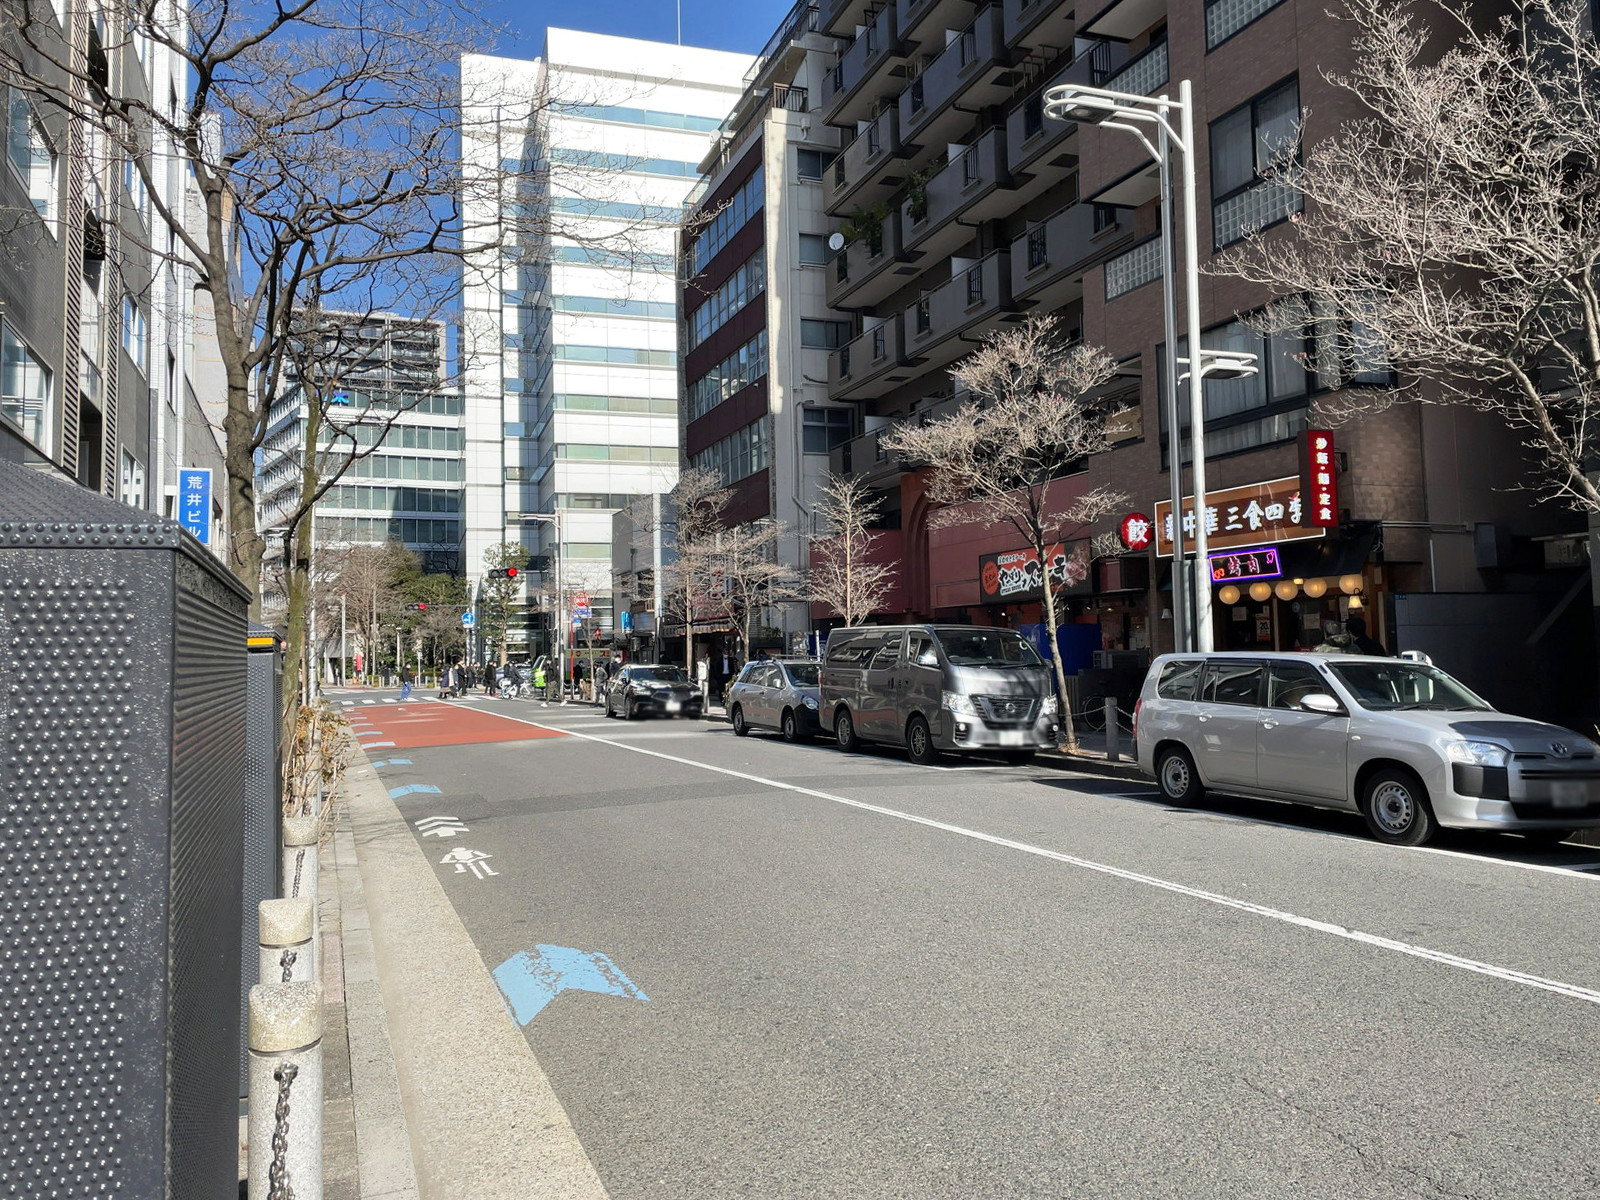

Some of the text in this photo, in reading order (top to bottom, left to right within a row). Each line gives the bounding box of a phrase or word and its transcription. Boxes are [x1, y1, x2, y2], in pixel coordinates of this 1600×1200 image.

[187, 475, 202, 537] 荒井ビル
[1127, 518, 1149, 543] 餃
[999, 556, 1066, 592] やっぱりスキ
